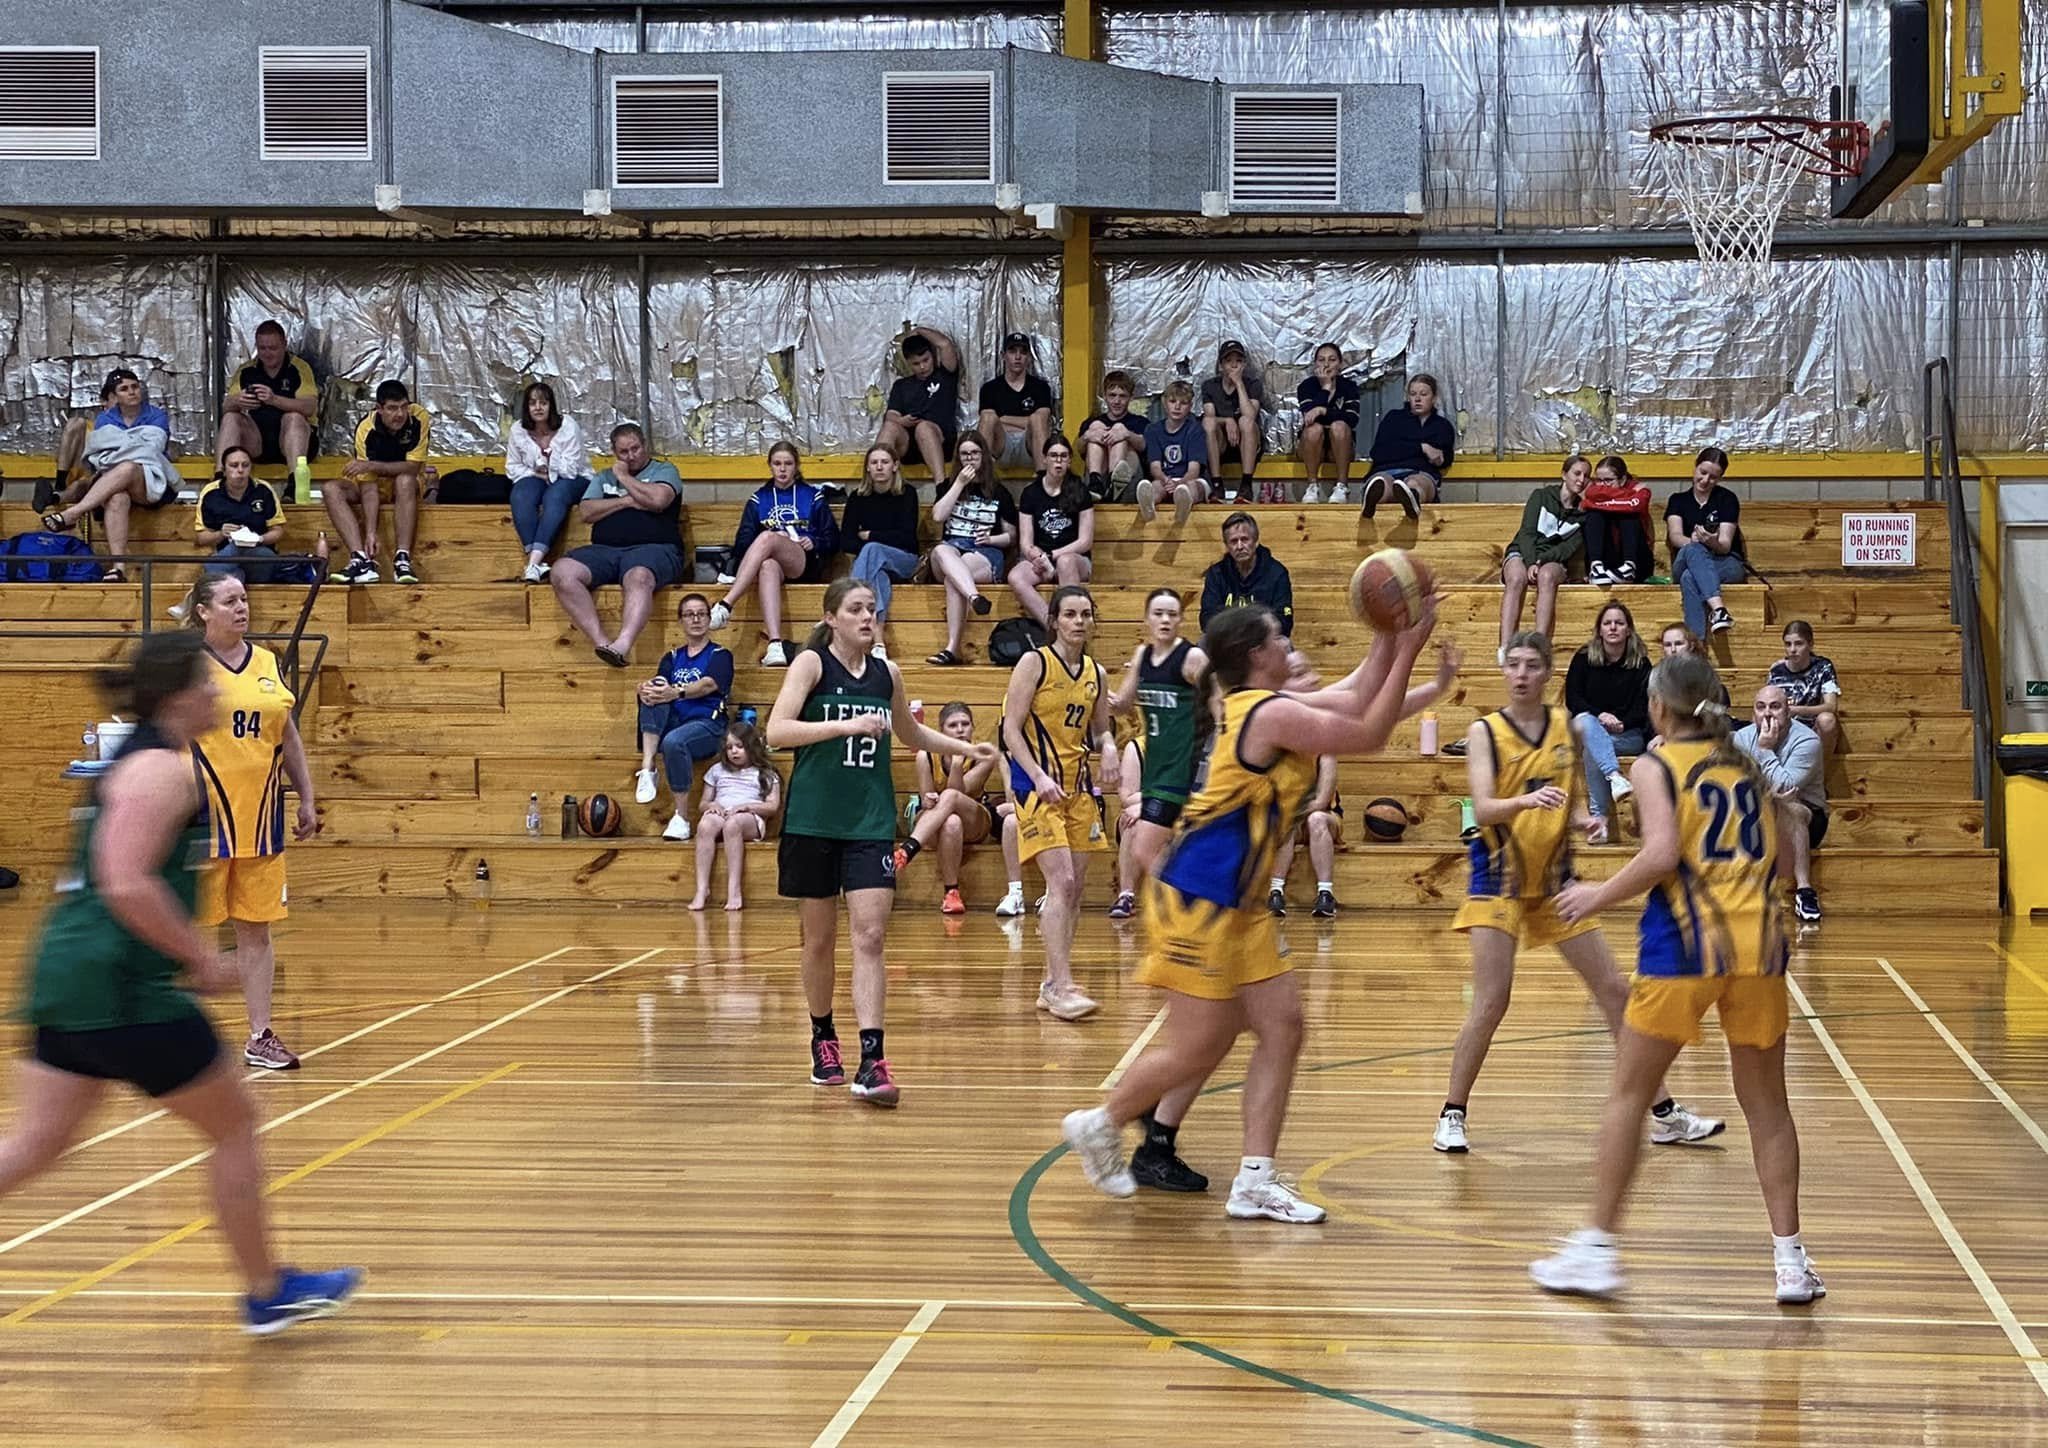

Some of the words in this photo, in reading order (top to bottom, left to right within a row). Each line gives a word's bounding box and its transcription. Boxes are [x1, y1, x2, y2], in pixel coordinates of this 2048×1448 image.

[1848, 519, 1862, 531] NO
[1865, 519, 1910, 531] RUNNING
[1850, 534, 1863, 546] OR
[1865, 534, 1908, 546] JUMPING
[1856, 549, 1870, 561] ON
[1872, 549, 1902, 561] SEATS
[232, 709, 261, 739] 84
[1064, 703, 1085, 729] 22
[842, 735, 877, 768] 12
[1697, 779, 1766, 862] 28
